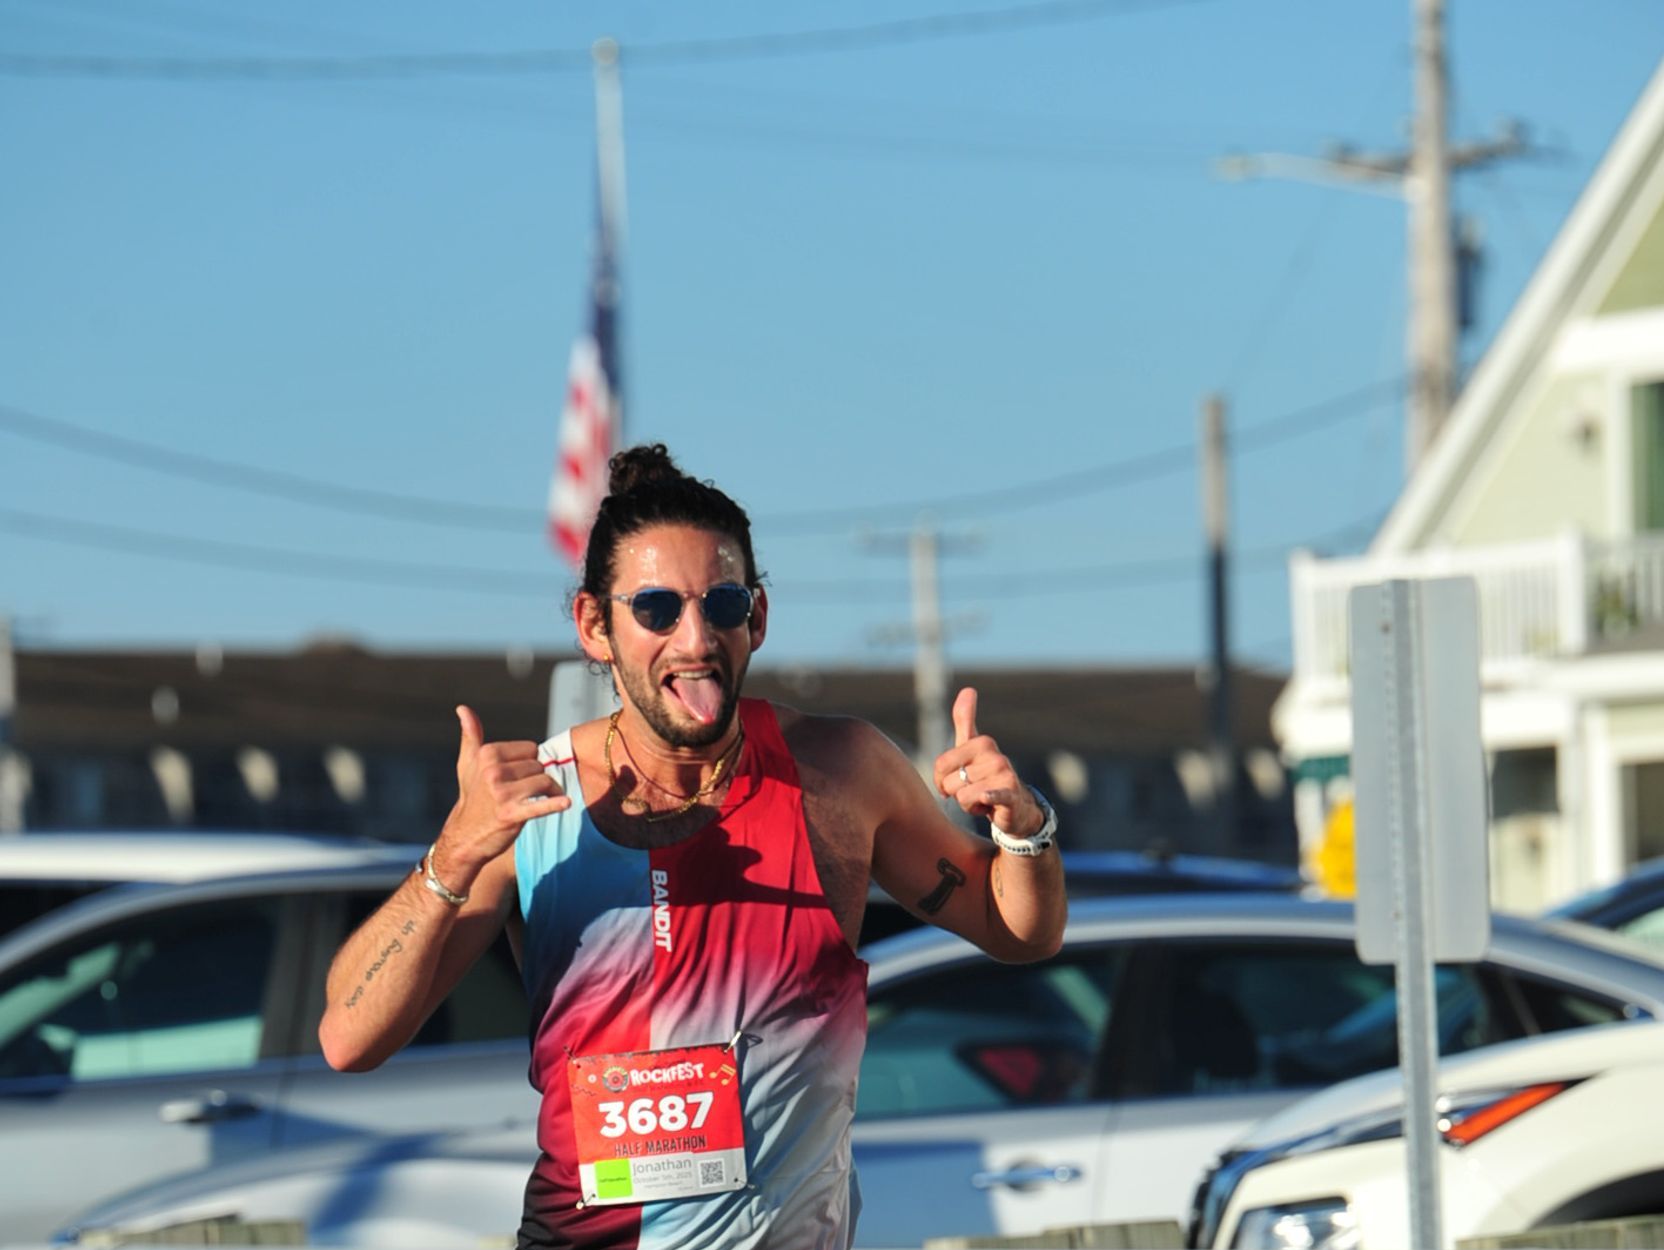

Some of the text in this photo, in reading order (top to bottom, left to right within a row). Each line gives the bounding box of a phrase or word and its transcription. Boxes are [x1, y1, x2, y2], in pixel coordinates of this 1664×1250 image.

[652, 870, 673, 952] BANDIT
[630, 1062, 704, 1087] ROCKFEST
[598, 1091, 714, 1139] 3687
[615, 1135, 706, 1158] HALF MARATHON
